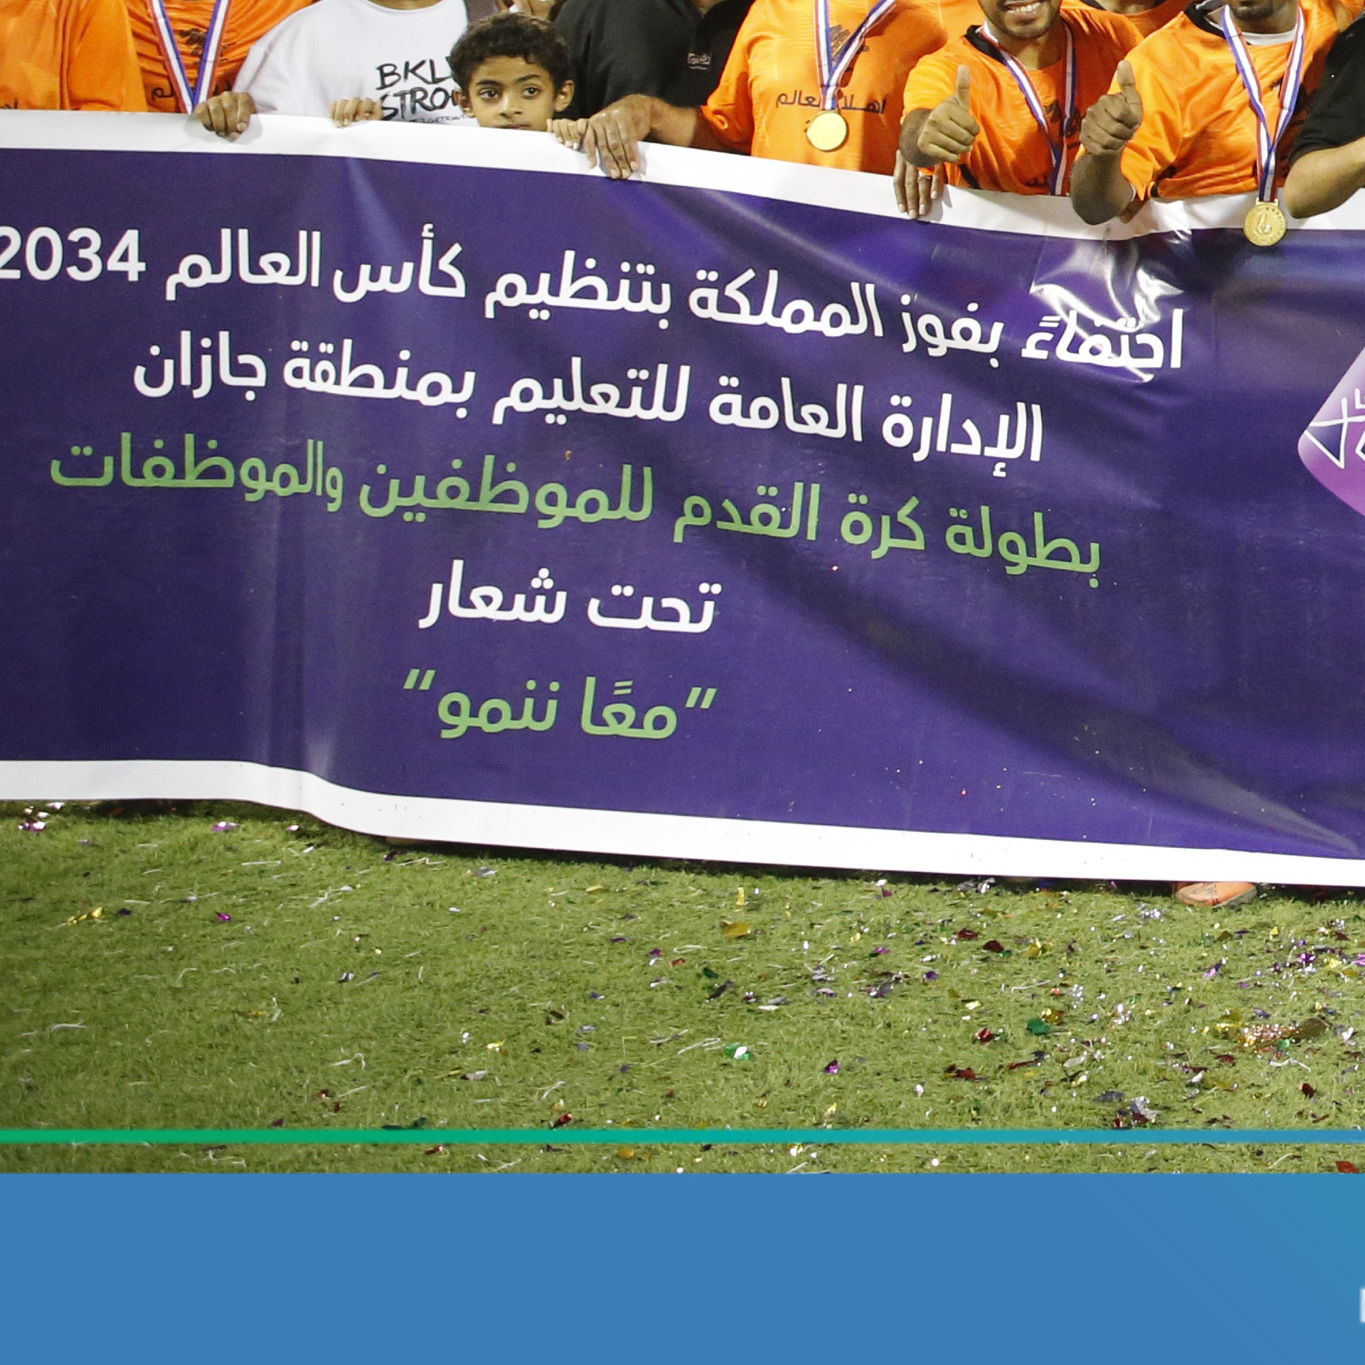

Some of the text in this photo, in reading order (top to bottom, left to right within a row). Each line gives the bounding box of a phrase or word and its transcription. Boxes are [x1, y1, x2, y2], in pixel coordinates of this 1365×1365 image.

[376, 56, 454, 91] BKL
[0, 226, 146, 282] 2034
[165, 228, 321, 301] العالم
[333, 223, 466, 303] كأس
[485, 249, 671, 330] بتنظيم
[688, 268, 884, 338] المملكة
[901, 294, 1005, 368] بفوز
[133, 330, 1043, 478] الإدارة العامة للتعليم بمنطقة جازان
[50, 432, 1101, 589] بطولة كرة القدم للموظفين والموظفات
[418, 559, 722, 633] تحت شعار
